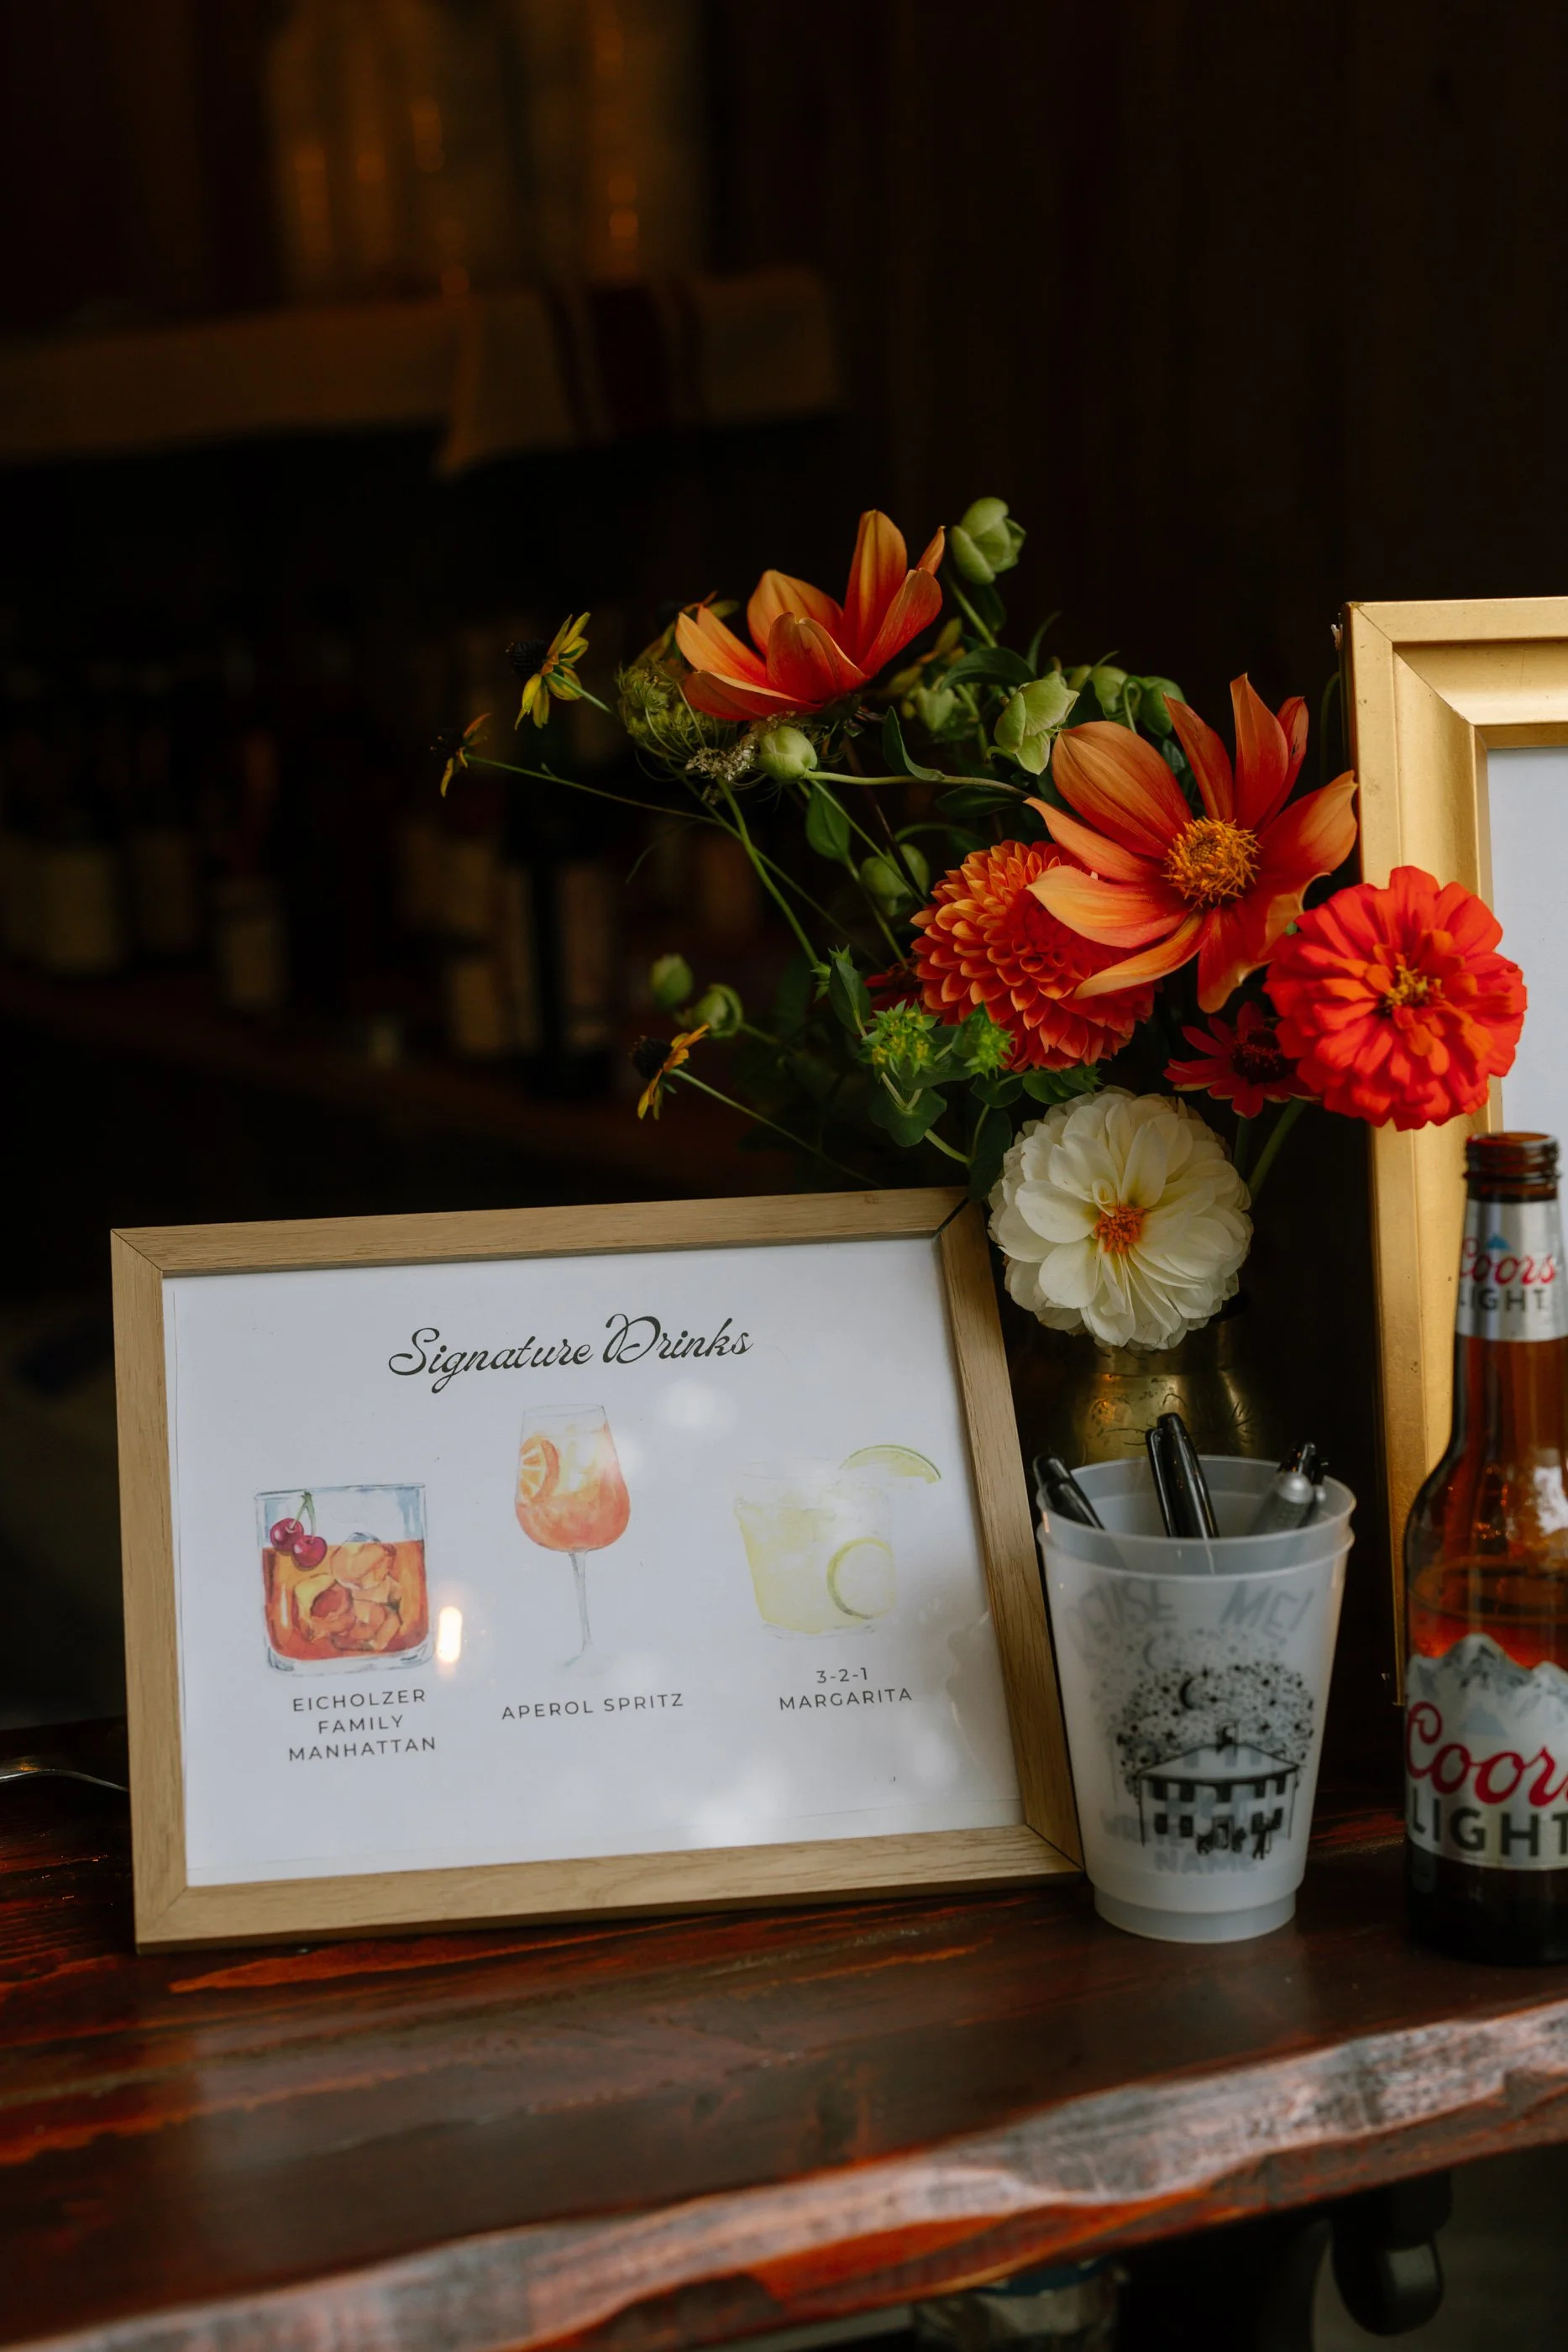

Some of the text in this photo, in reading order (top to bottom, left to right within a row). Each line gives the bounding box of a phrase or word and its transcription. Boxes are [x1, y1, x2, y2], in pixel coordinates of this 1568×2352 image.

[1460, 1288, 1544, 1312] IGHT
[388, 1313, 753, 1394] Signature Drinks
[815, 1667, 868, 1684] 3-2-1
[292, 1688, 426, 1712] EICHOLZER
[501, 1684, 684, 1720] APEROL SPRITZ
[779, 1688, 912, 1711] MARGARITA
[317, 1714, 403, 1735] FAMILY
[288, 1735, 436, 1761] MANHATTAN
[1407, 1702, 1568, 1808] Coor
[1413, 1788, 1568, 1857] LIGHT
